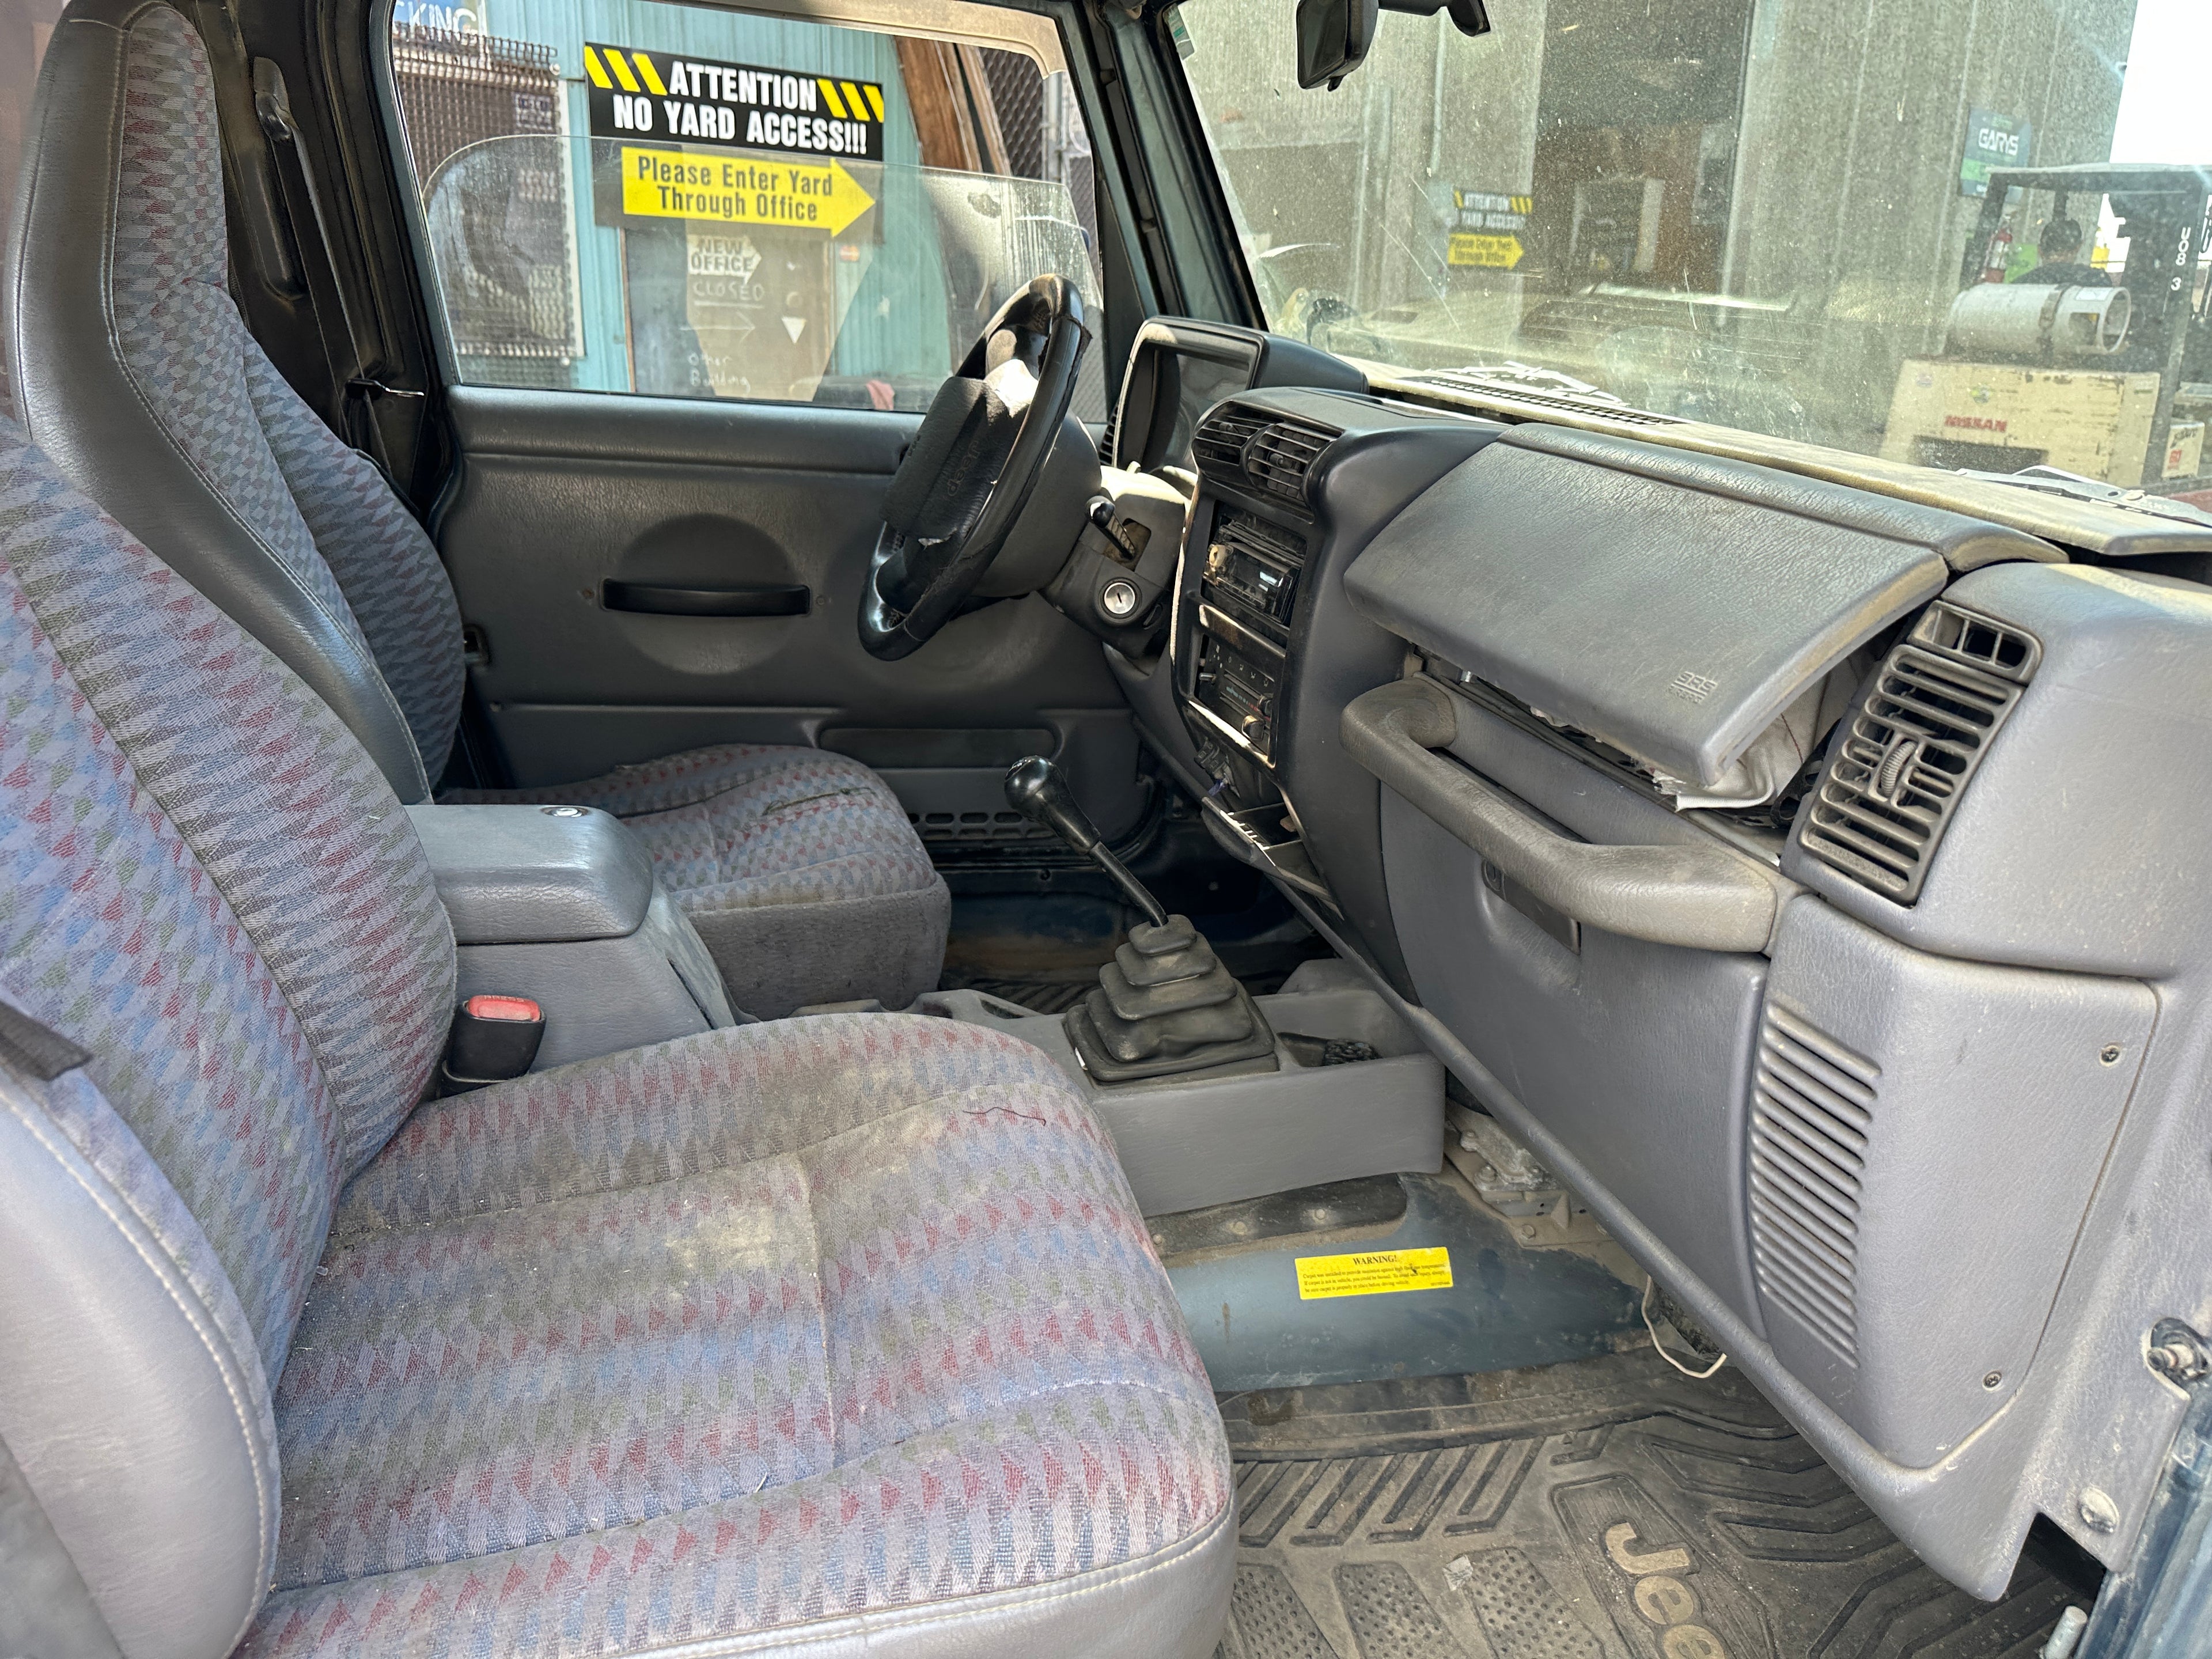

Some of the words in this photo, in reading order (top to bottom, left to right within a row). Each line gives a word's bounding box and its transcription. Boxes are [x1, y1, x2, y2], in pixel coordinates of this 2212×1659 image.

[393, 1, 479, 46] KING
[669, 61, 817, 112] ATTENTION
[613, 94, 653, 132] NO
[663, 100, 736, 140] YARD
[746, 110, 868, 154] ACCESS!!!
[638, 156, 711, 186] Please
[723, 164, 779, 191] Enter
[789, 169, 833, 196] Yard
[658, 185, 745, 219] Through
[756, 194, 818, 221] Office
[691, 252, 755, 272] OFFICE
[696, 238, 744, 254] NEW
[693, 280, 765, 301] CLOSED
[1353, 1255, 1397, 1265] WARNING!
